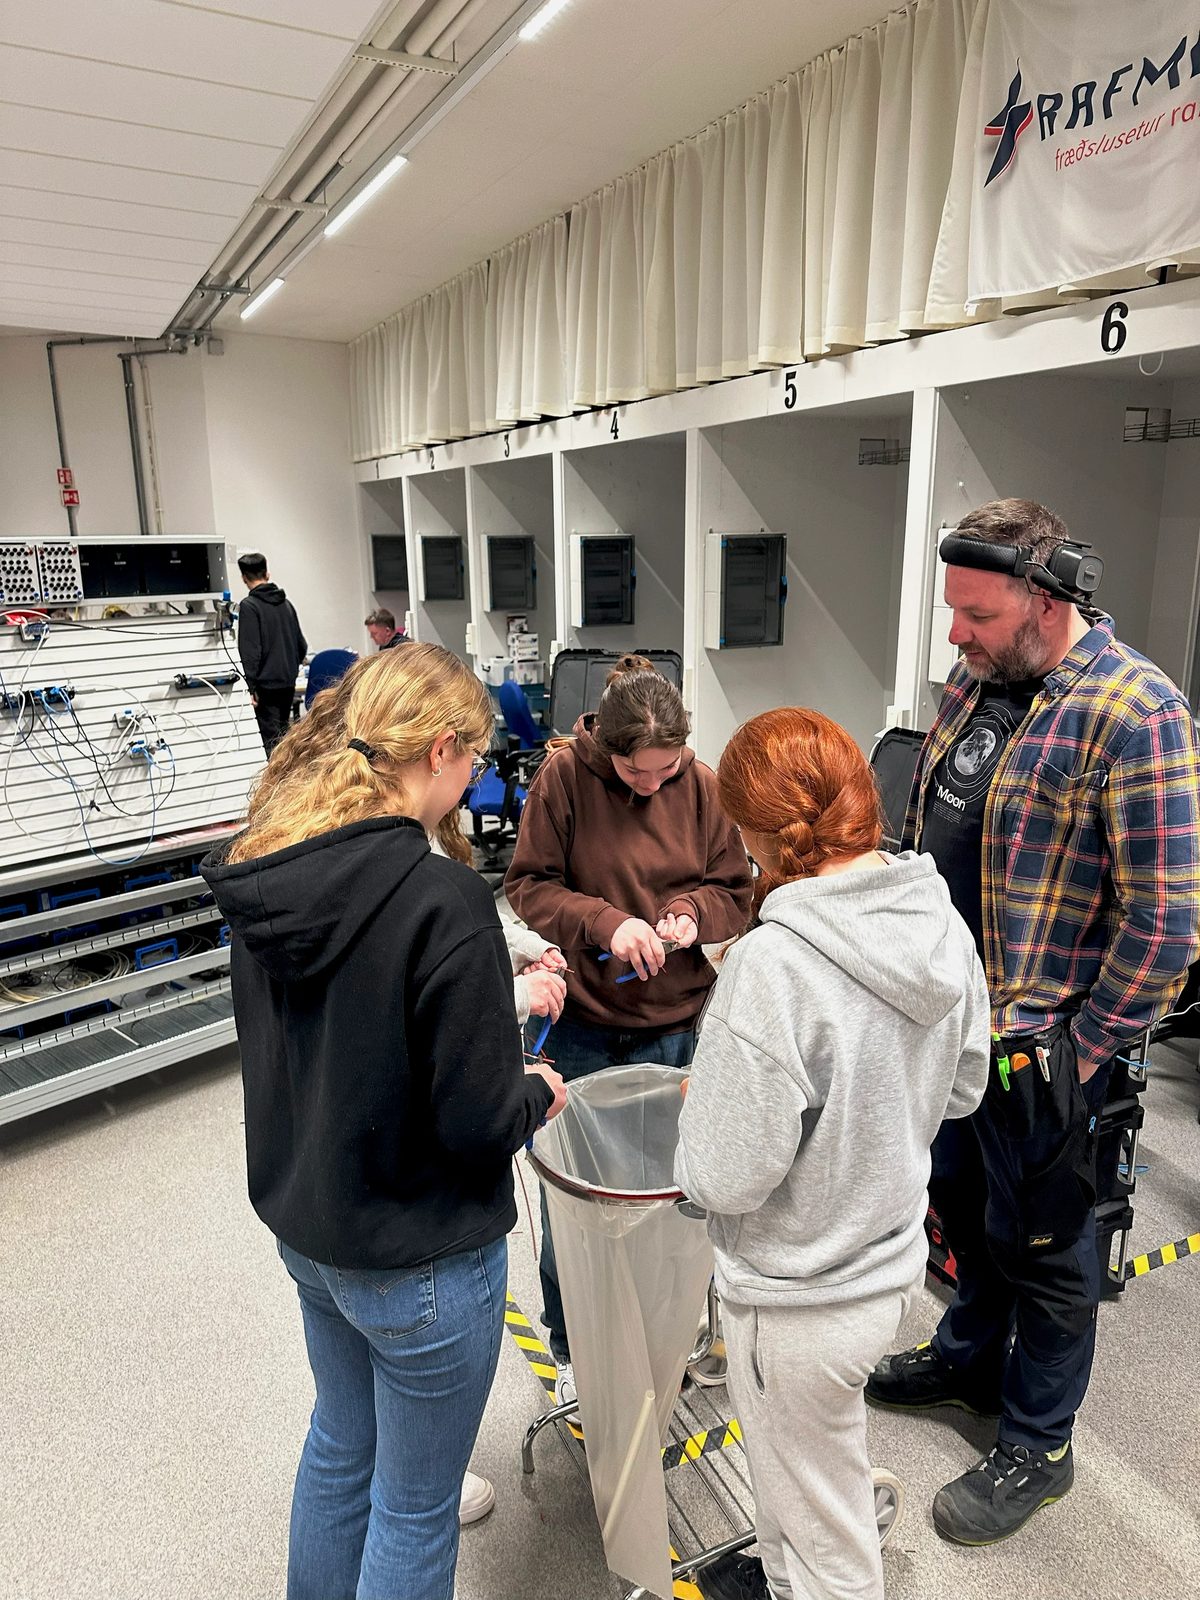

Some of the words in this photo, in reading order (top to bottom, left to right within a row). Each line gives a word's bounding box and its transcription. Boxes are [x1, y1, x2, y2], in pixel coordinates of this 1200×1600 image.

[1055, 112, 1166, 172] fræðslusetur
[1171, 101, 1200, 127] ra
[1100, 301, 1128, 354] 6
[784, 371, 797, 409] 5
[610, 411, 619, 440] 4
[503, 433, 510, 458] 3
[375, 460, 380, 480] 1
[429, 449, 435, 470] 2
[937, 785, 966, 811] Moon
